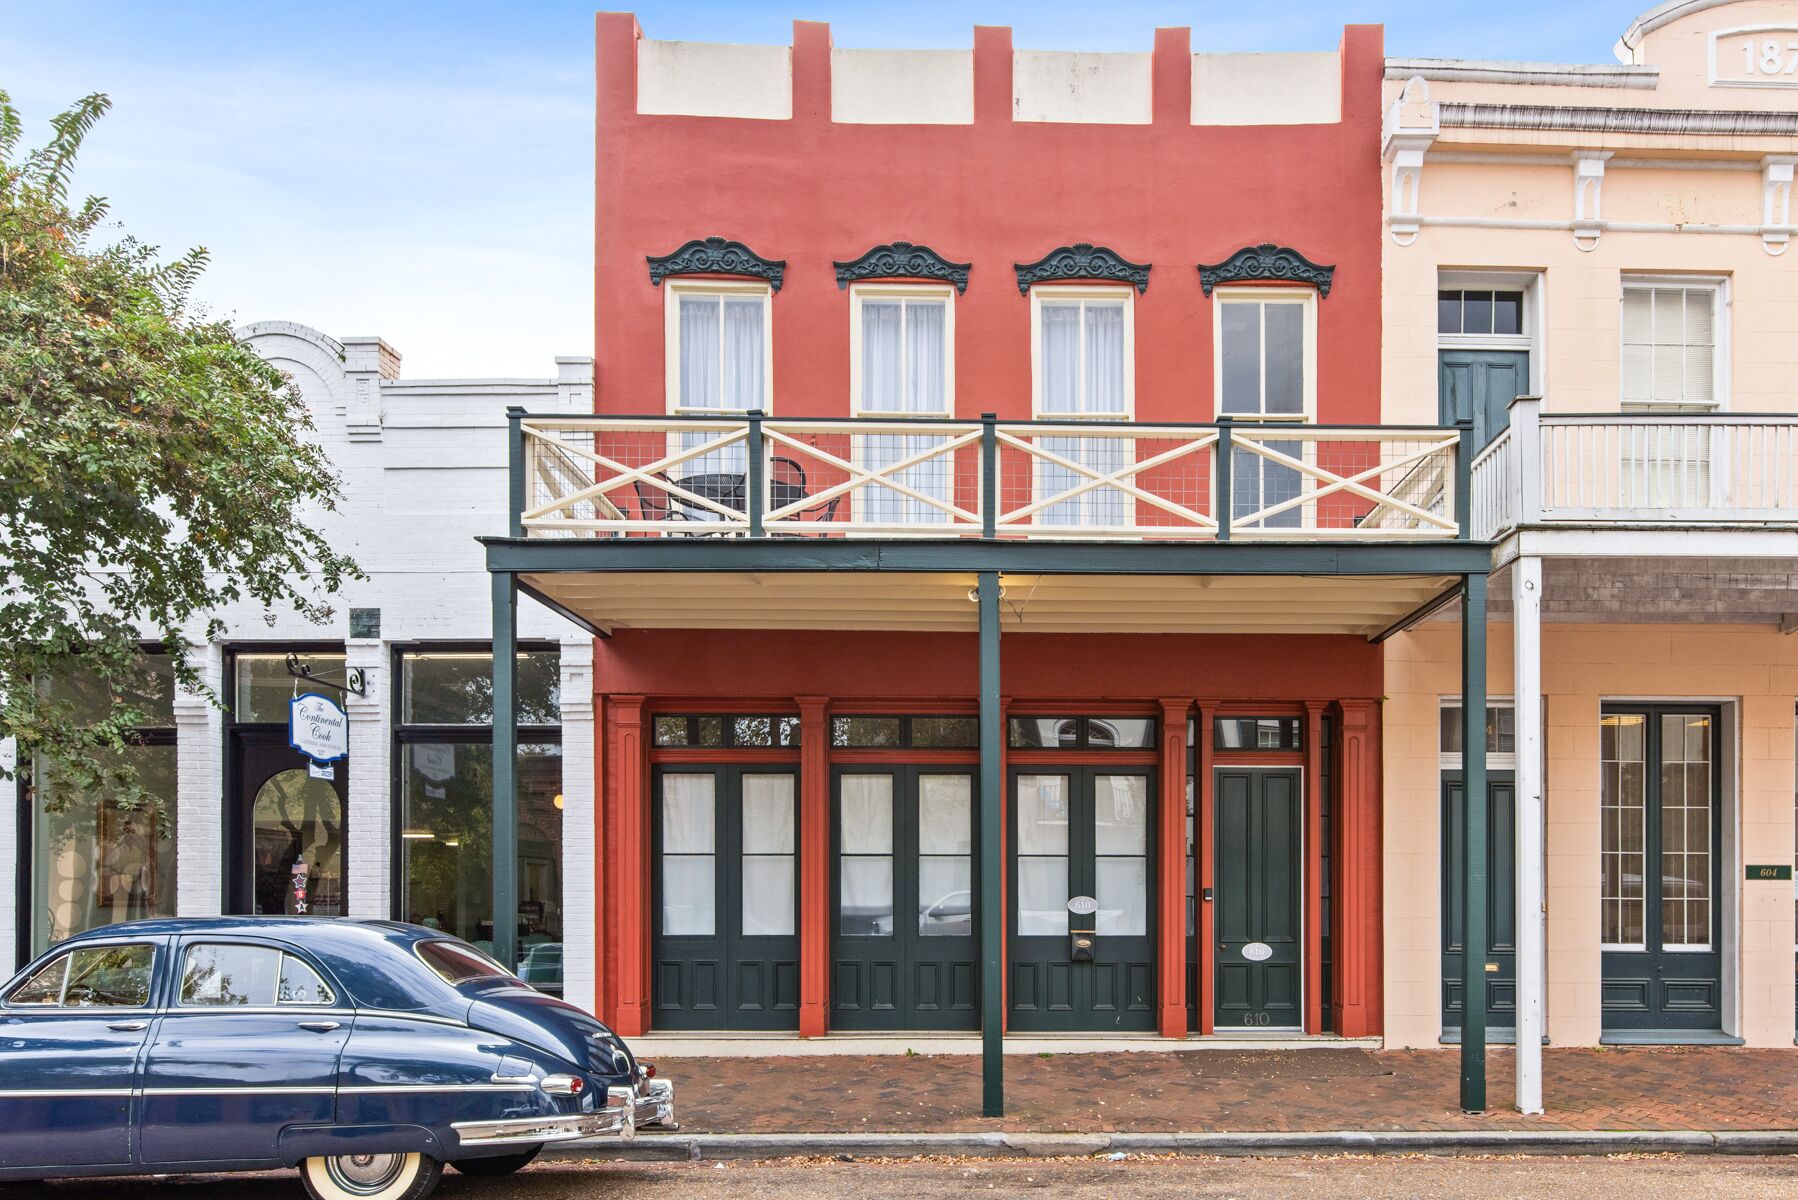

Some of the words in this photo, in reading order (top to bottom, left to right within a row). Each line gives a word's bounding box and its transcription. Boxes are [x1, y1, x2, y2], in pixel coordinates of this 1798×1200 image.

[1741, 40, 1798, 75] 187
[297, 703, 343, 728] Continental
[310, 722, 332, 742] Cook
[1760, 868, 1777, 877] 604
[1075, 901, 1091, 909] 610
[1249, 947, 1265, 956] 610
[1244, 1012, 1270, 1026] 610
